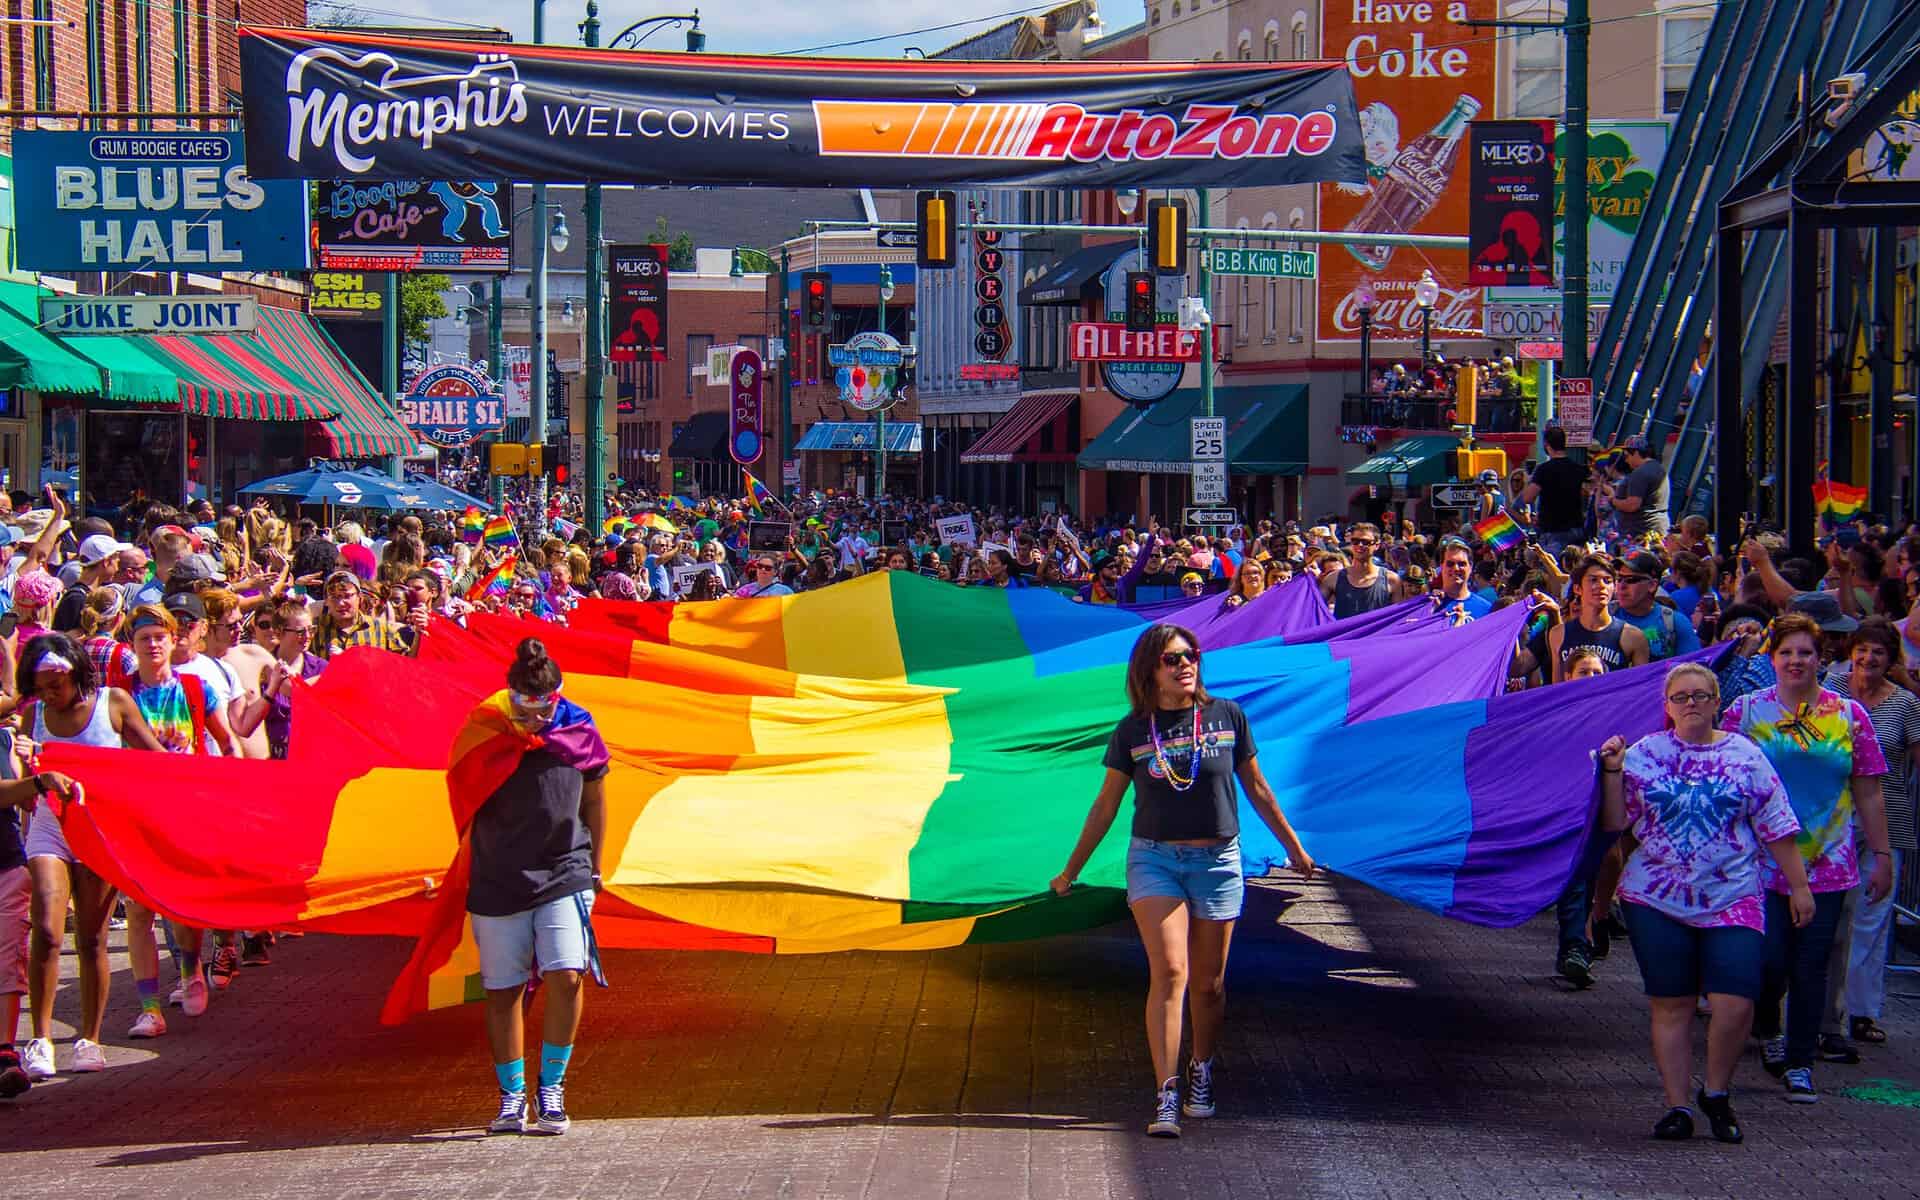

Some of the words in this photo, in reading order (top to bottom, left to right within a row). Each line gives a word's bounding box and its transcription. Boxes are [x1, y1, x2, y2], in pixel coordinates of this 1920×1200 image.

[1351, 0, 1433, 23] Have
[1446, 2, 1467, 22] a
[1345, 33, 1469, 78] Coke
[289, 78, 528, 172] Memphis
[543, 103, 790, 140] WELCOMES
[100, 140, 127, 155] RUM
[131, 141, 176, 156] BOOGIE
[181, 142, 222, 156] CAFE'S
[1481, 145, 1545, 165] MLK50
[56, 166, 265, 210] BLUES
[1497, 185, 1512, 193] WE
[1513, 185, 1527, 193] GO
[354, 203, 423, 240] Cafe
[80, 219, 243, 263] HALL
[1216, 252, 1246, 271] B.B.
[1248, 252, 1277, 274] King
[1282, 254, 1314, 275] Blvd.
[1372, 281, 1418, 292] DRINK
[56, 304, 134, 328] JUKE
[153, 303, 241, 327] JOINT
[1563, 382, 1585, 393] NO
[738, 393, 757, 408] Tin
[403, 400, 469, 425] BEALE
[432, 431, 472, 444] GIFTS
[1195, 440, 1222, 455] 25
[1196, 492, 1221, 500] BUSES
[1452, 491, 1472, 499] ONE
